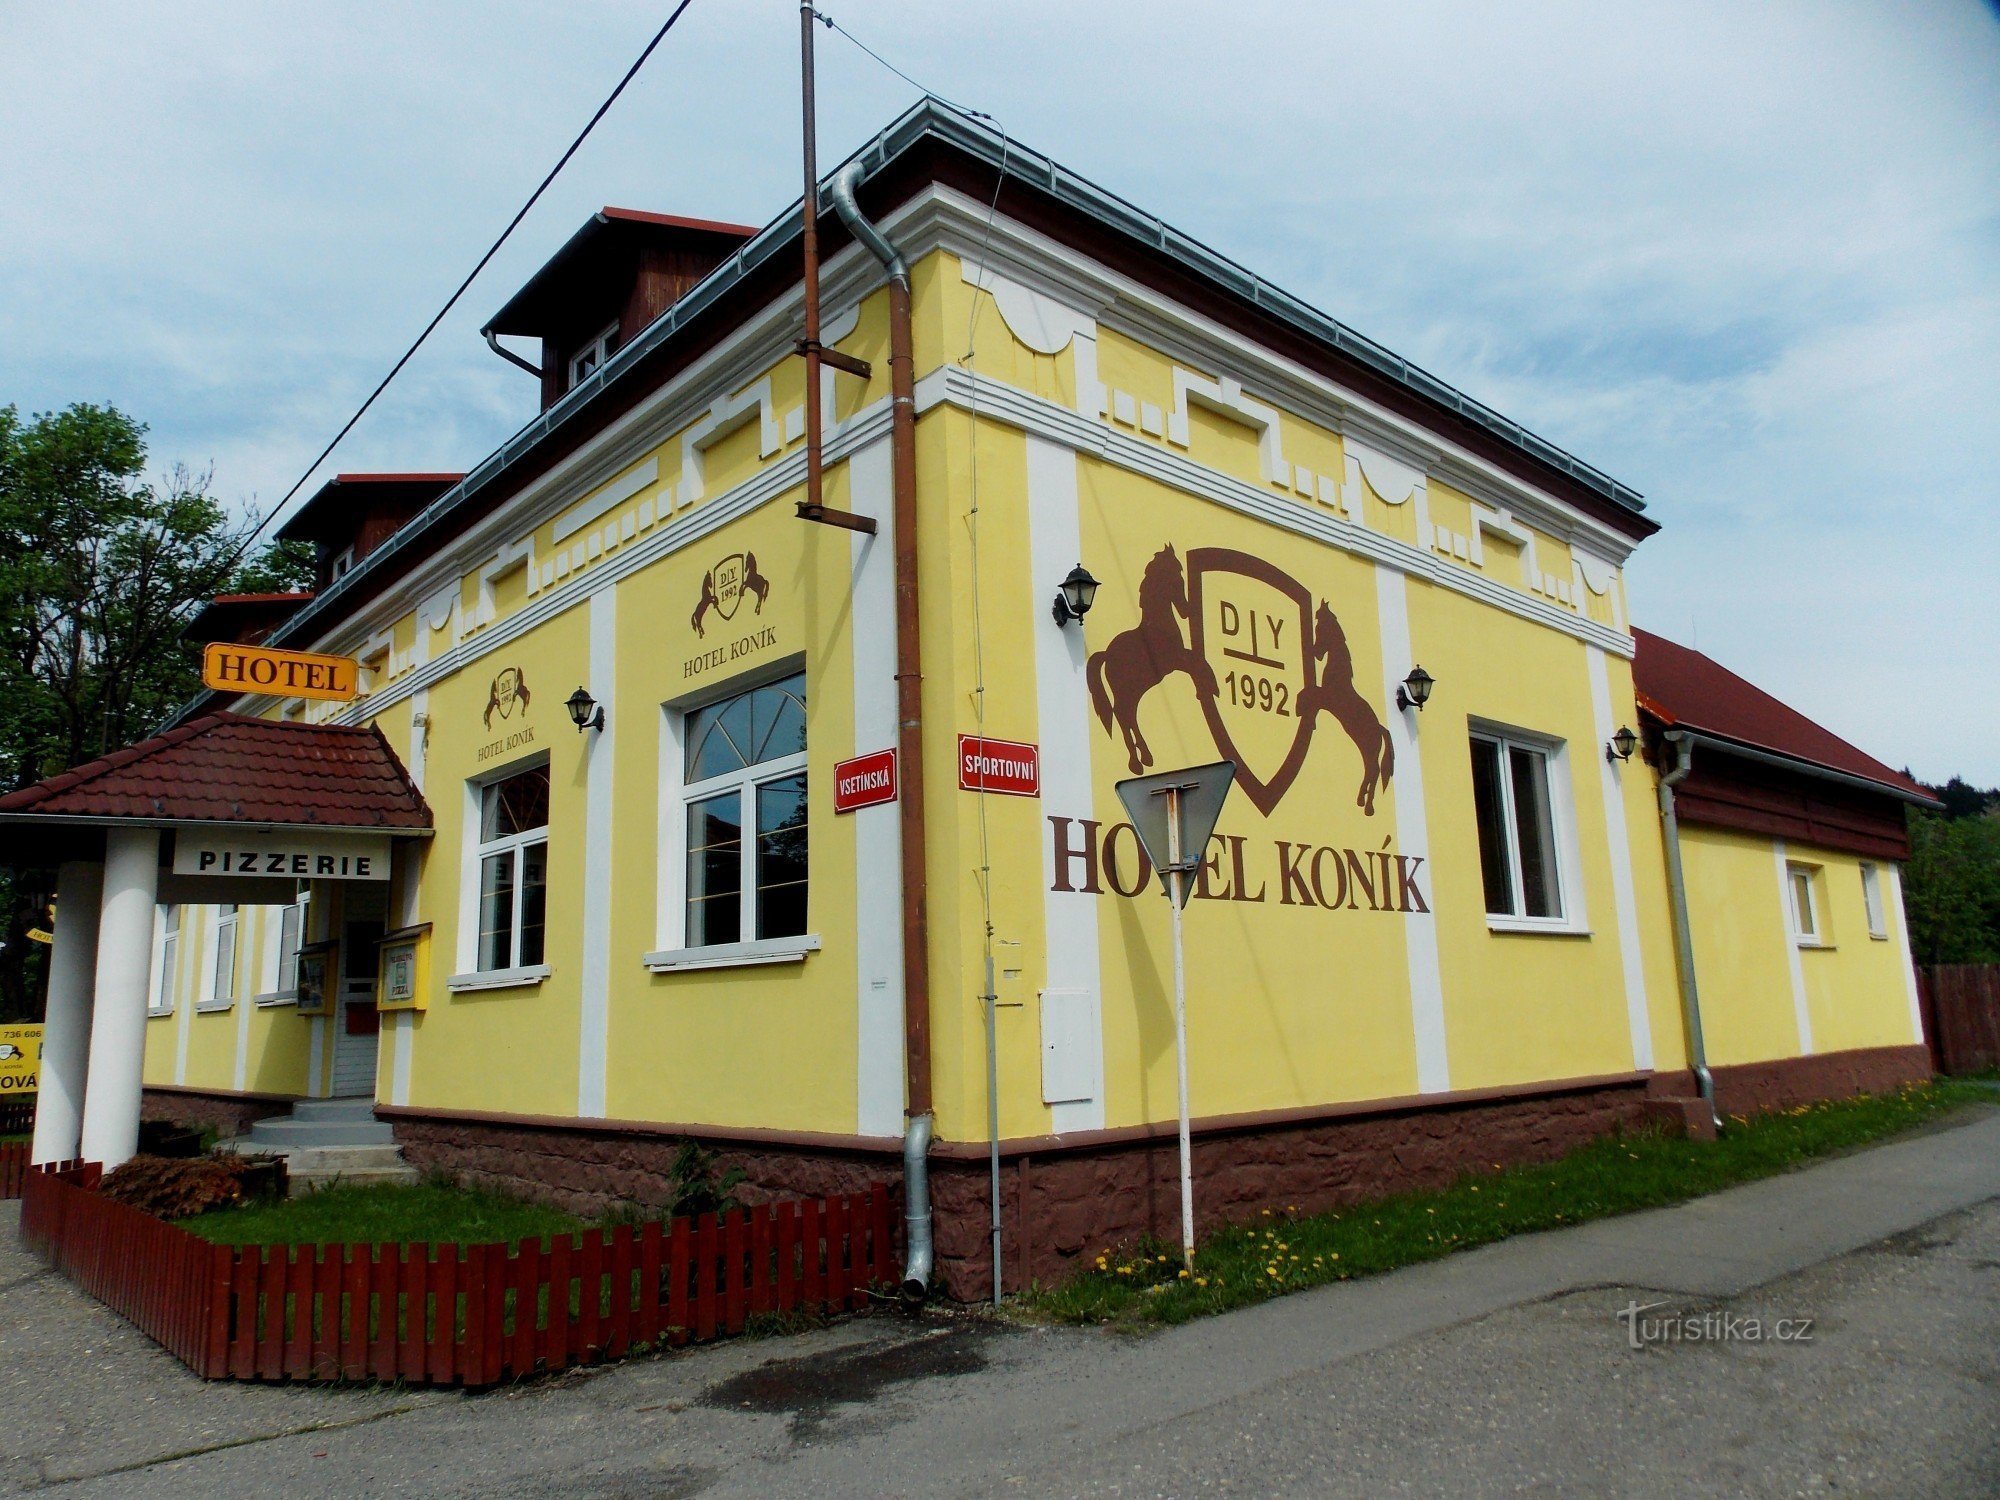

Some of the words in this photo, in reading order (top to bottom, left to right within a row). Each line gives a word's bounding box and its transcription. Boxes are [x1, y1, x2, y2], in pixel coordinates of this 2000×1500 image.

[721, 585, 738, 602] 1992
[683, 647, 727, 679] HOTEL
[730, 624, 777, 661] KONÍK
[217, 653, 347, 692] HOTEL
[1225, 670, 1290, 717] 1992
[478, 740, 504, 762] HOTEL
[965, 754, 1034, 780] SPORTOVNÍ
[839, 765, 890, 796] VSETÍNSKÁ
[199, 851, 371, 876] PIZZERIE
[1047, 815, 1266, 903] HOEL
[1274, 834, 1431, 914] KONÍK
[4, 1031, 21, 1039] 736
[0, 1072, 37, 1089] OVÁ
